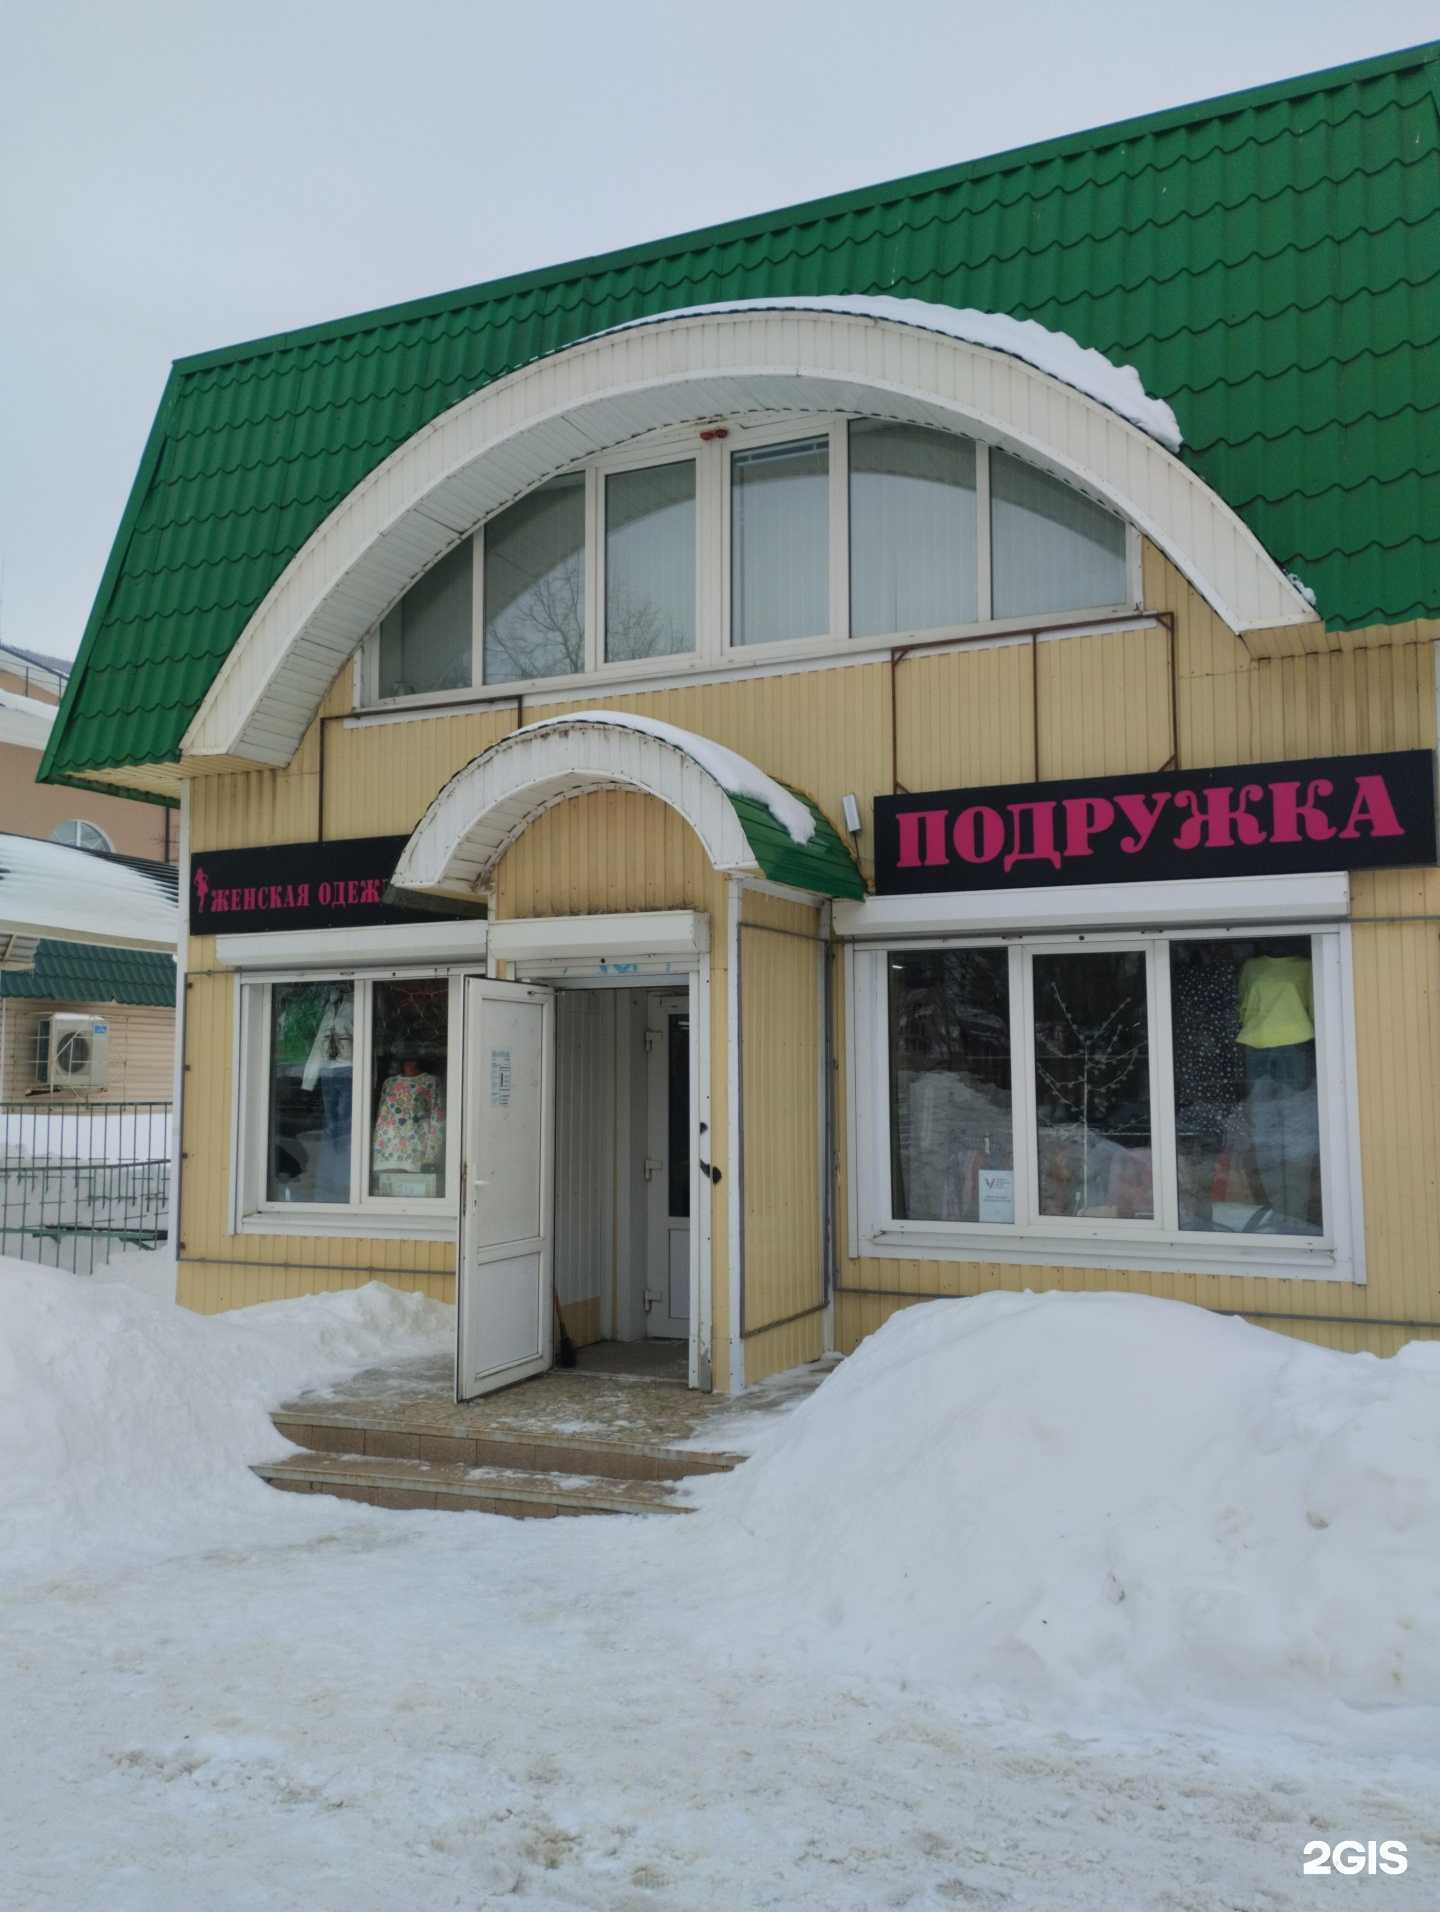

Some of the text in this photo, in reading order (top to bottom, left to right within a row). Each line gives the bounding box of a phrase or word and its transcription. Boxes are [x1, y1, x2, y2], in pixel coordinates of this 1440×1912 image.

[895, 774, 1405, 874] ПОДРУЖКА
[210, 879, 386, 913] ЖЕНСКАЯ ОДЕЖ
